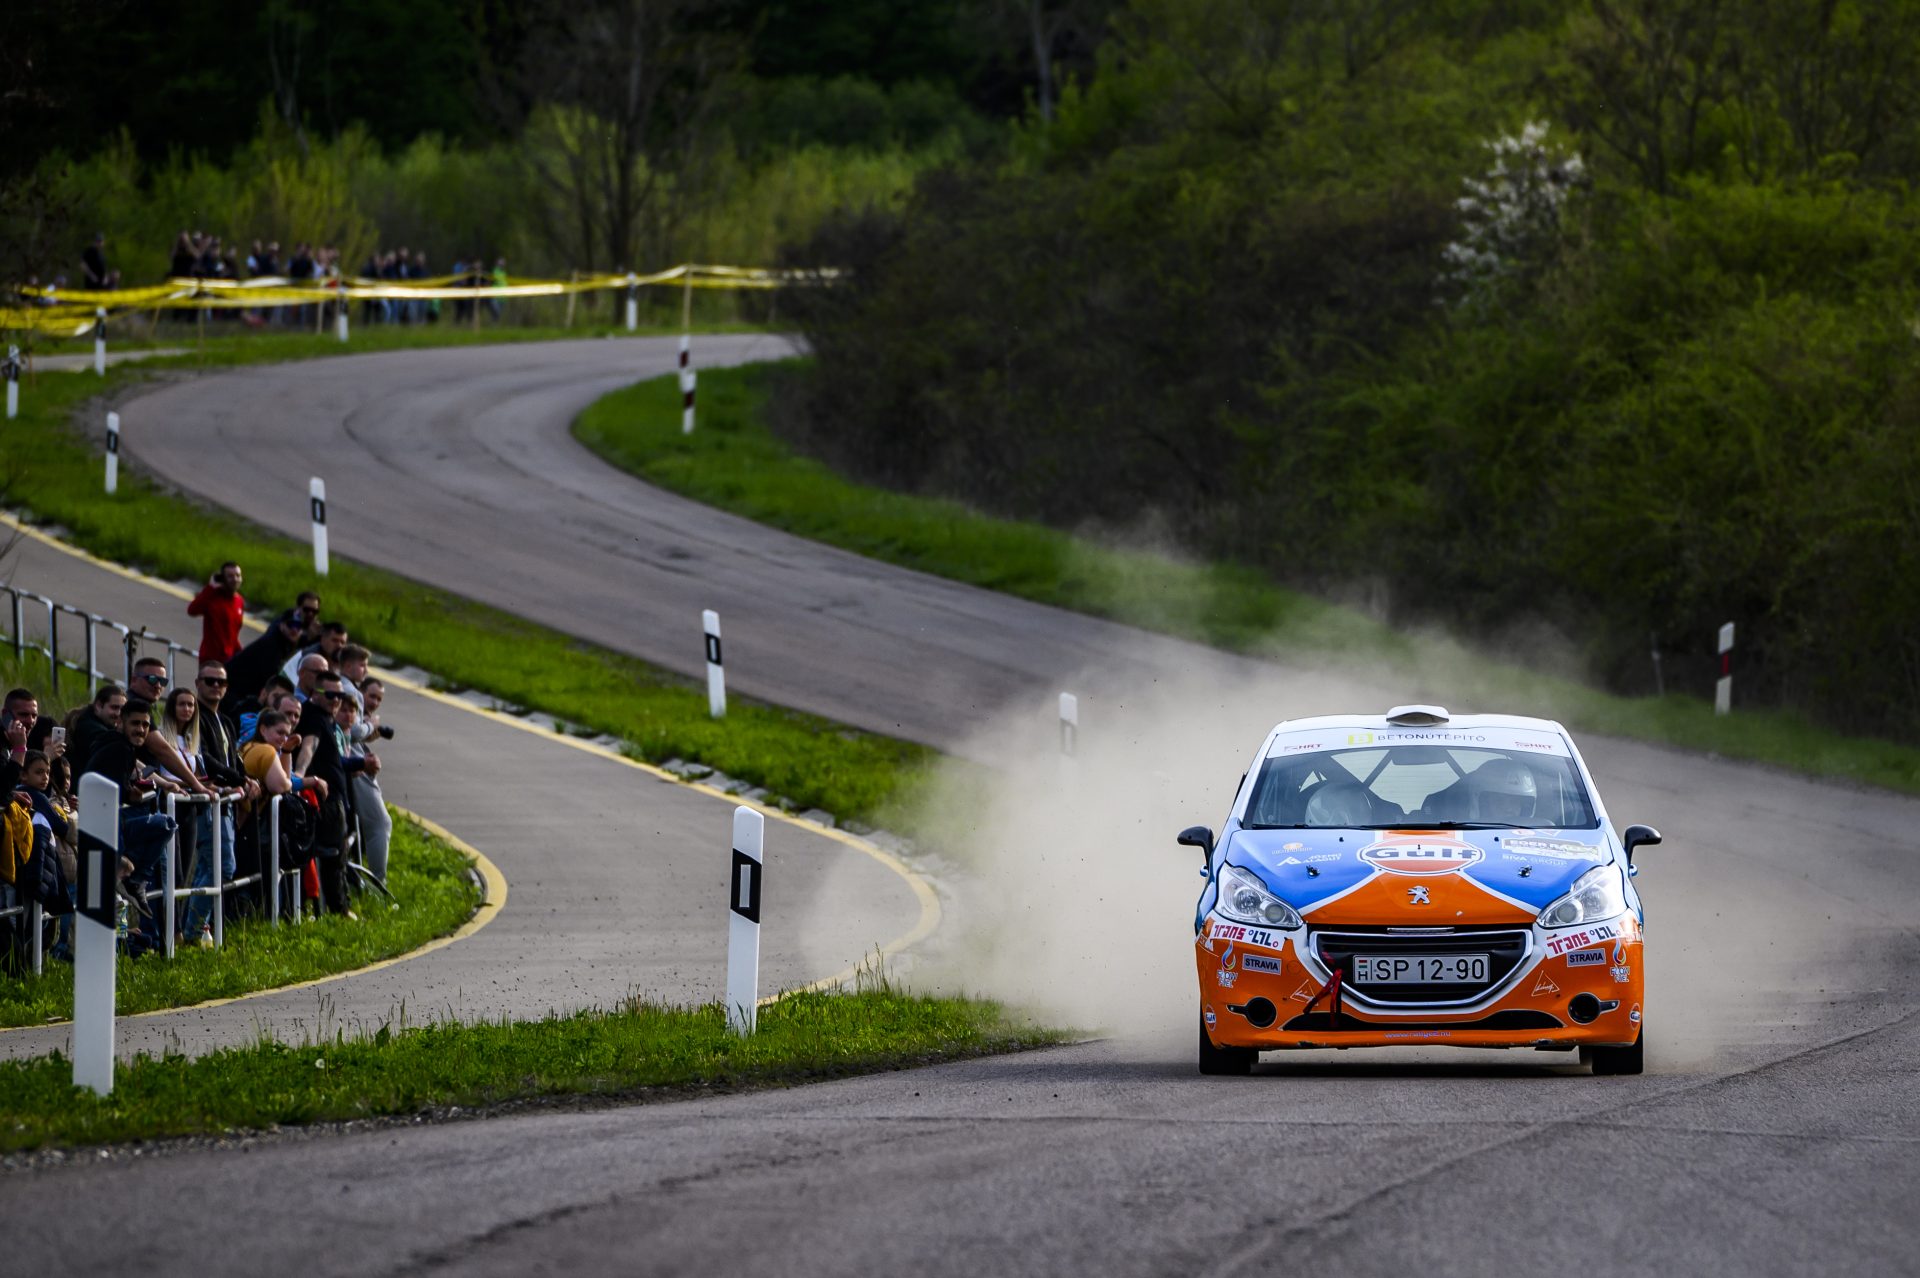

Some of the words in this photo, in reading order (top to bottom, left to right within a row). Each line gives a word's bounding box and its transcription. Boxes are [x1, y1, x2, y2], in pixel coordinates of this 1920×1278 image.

[1365, 848, 1477, 859] Gulf
[1569, 953, 1604, 963] STRAVIA
[1245, 958, 1279, 971] STRAVIA
[1358, 971, 1368, 981] H
[1376, 959, 1409, 981] SP
[1418, 958, 1485, 981] 12-90
